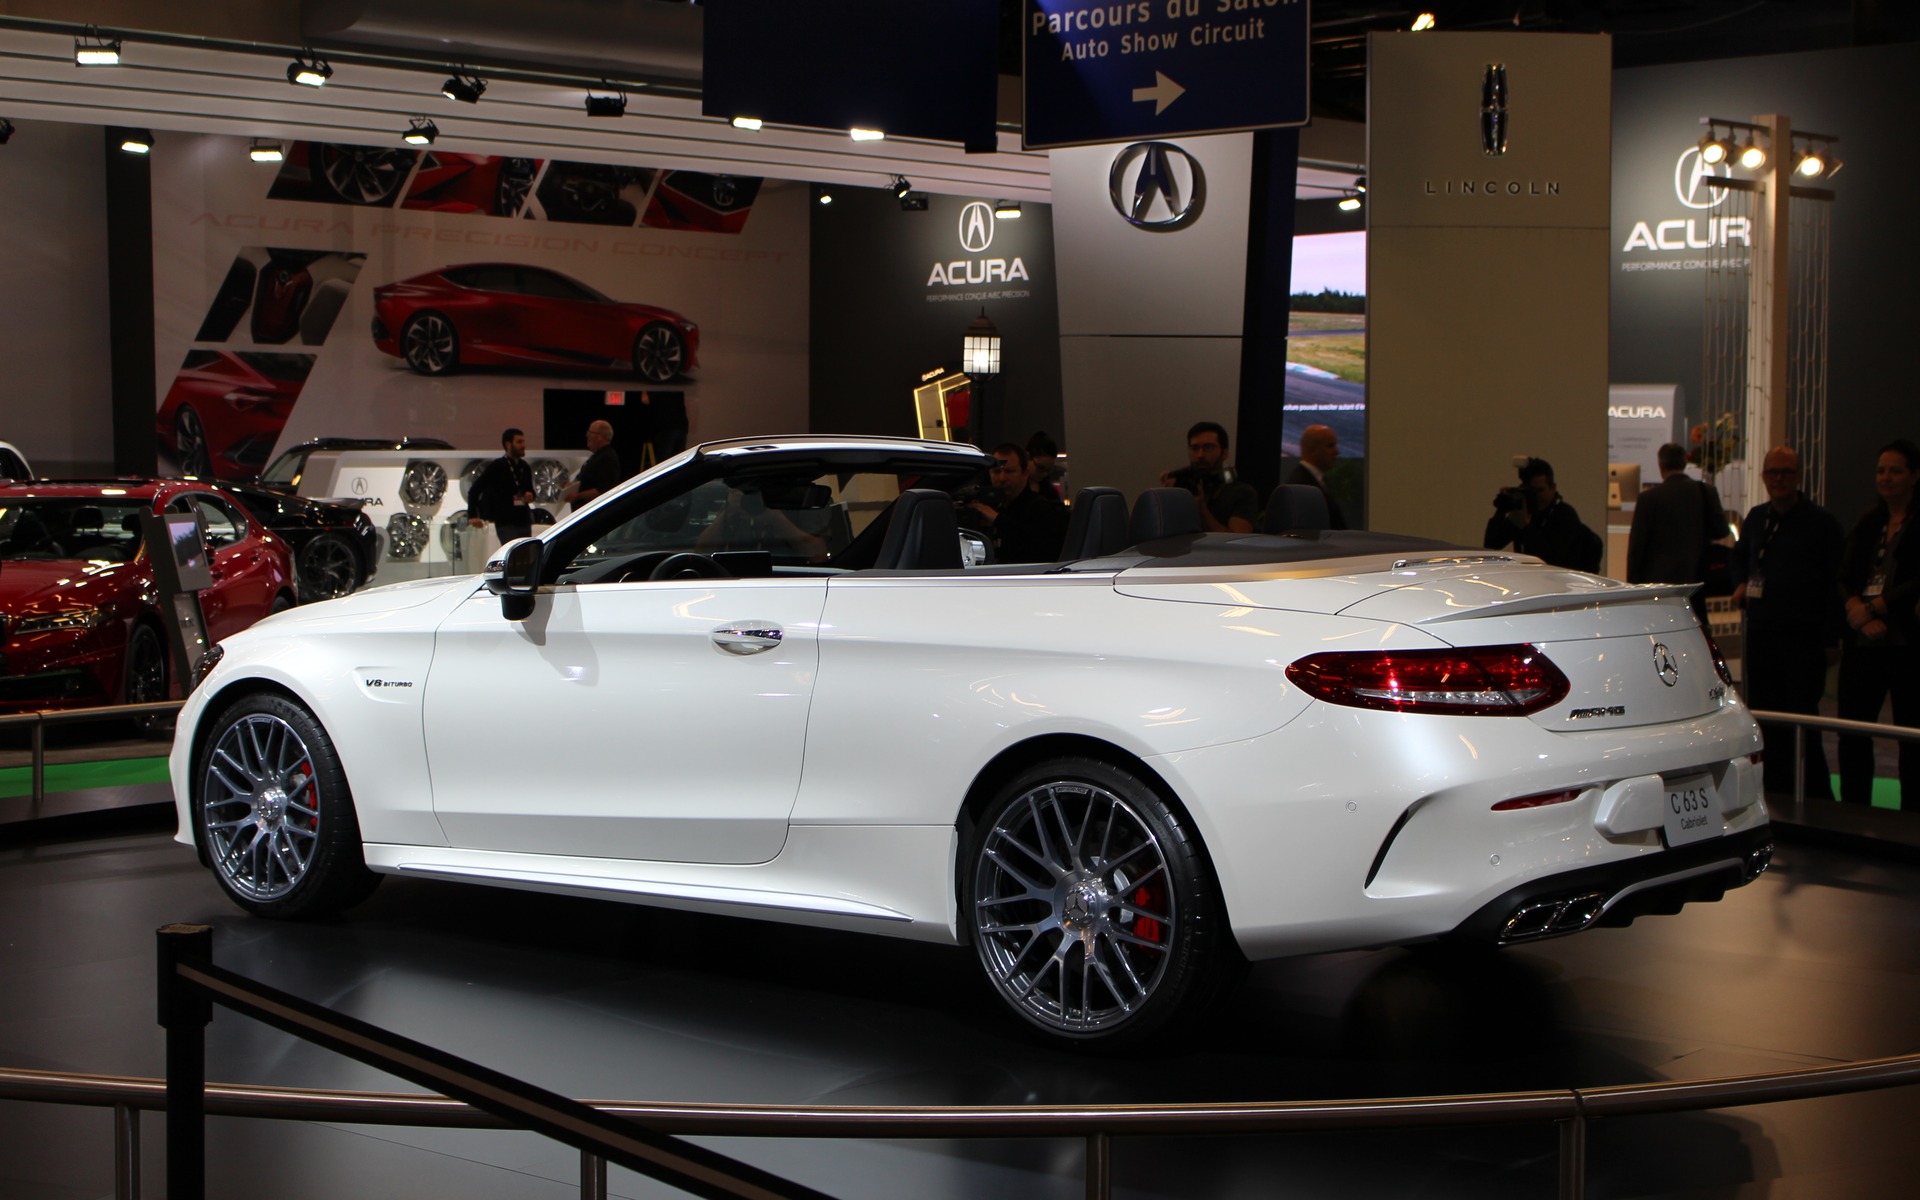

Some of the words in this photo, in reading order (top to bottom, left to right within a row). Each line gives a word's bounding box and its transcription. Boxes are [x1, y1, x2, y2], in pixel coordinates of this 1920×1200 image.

[1032, 1, 1151, 36] Parcours
[1166, 0, 1200, 19] du
[1061, 39, 1109, 61] Auto
[1121, 31, 1178, 54] Show
[1190, 18, 1265, 46] Circuit
[1425, 181, 1560, 195] LINCOLN
[189, 212, 354, 235] ACURA
[370, 223, 600, 254] PRECISION
[611, 240, 791, 263] CONCEPT
[1622, 216, 1752, 252] ACUR
[927, 257, 1030, 286] ACURA
[1621, 260, 1682, 272] PERFORMANCE
[1608, 406, 1667, 419] ACURA
[1671, 793, 1681, 814] C
[1683, 790, 1698, 812] 63
[1699, 787, 1709, 809] S
[1680, 815, 1709, 830] Cabriolet
